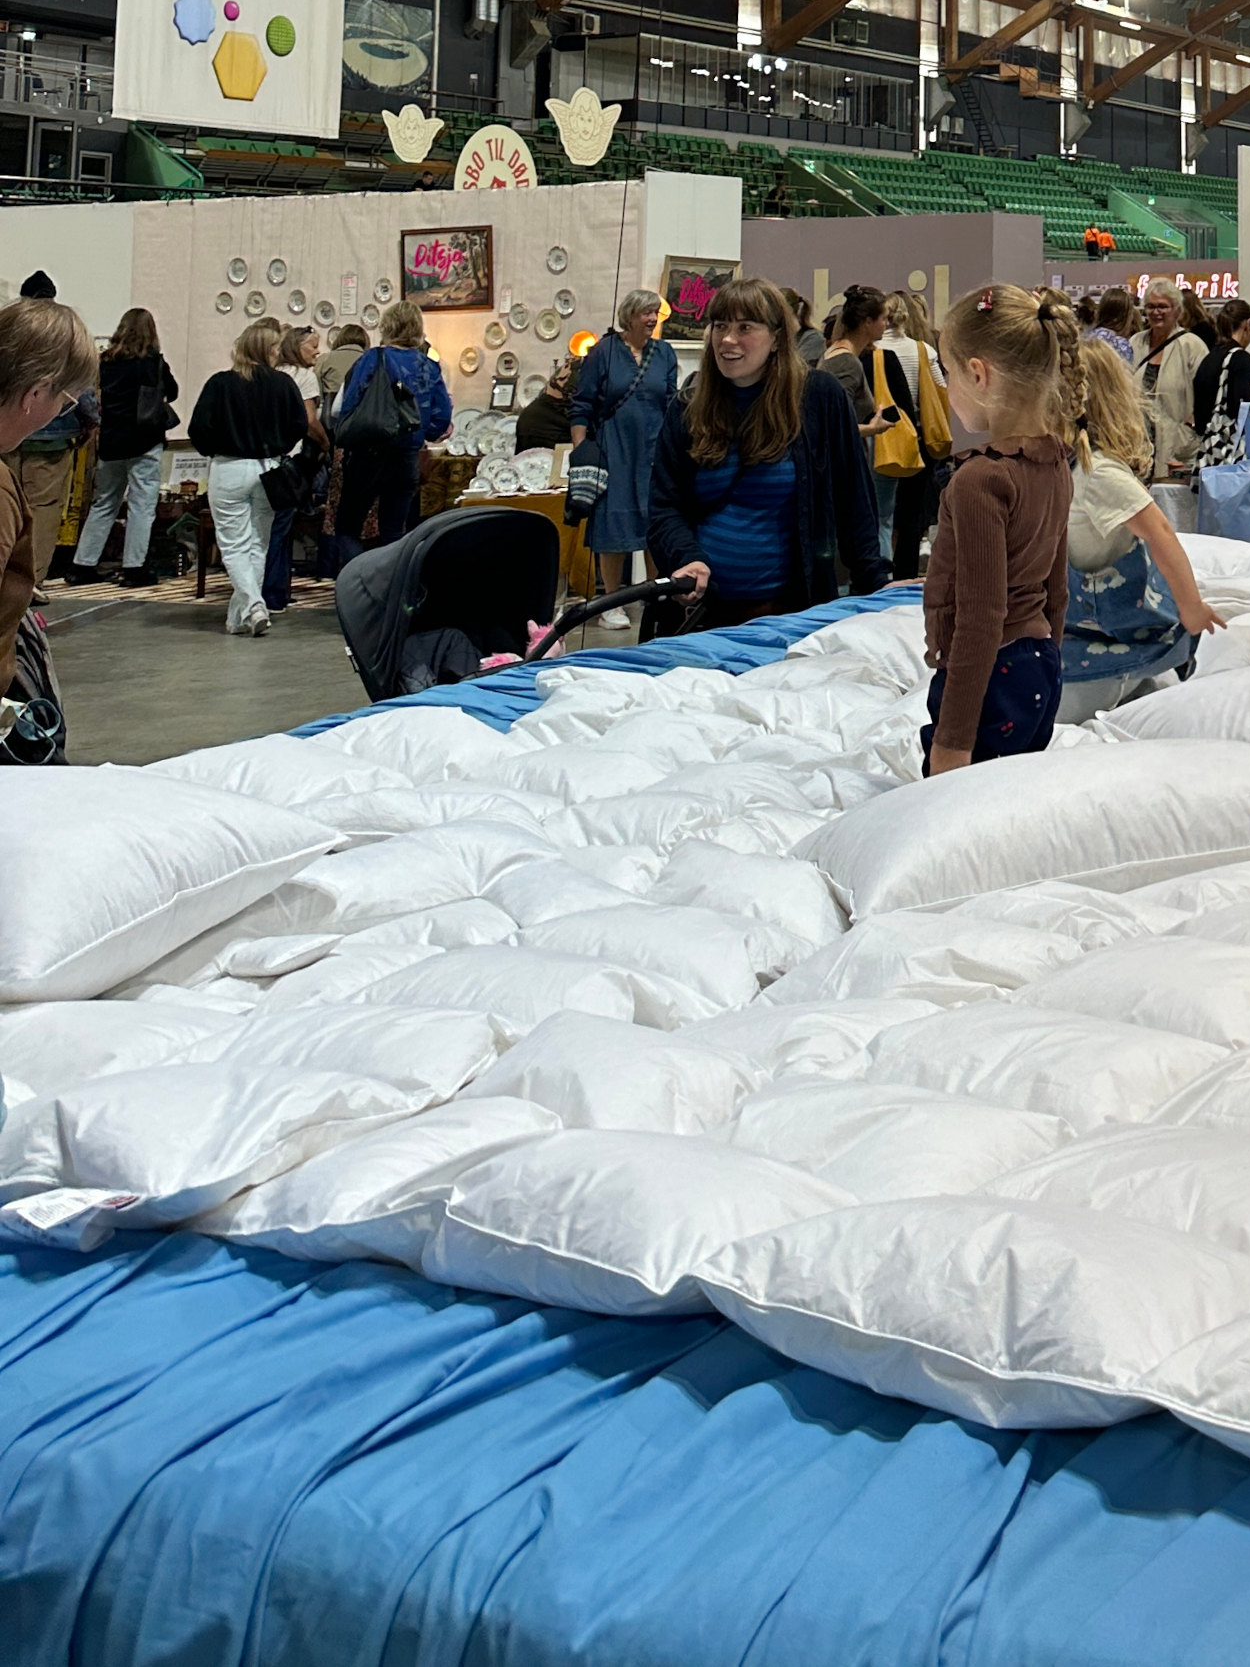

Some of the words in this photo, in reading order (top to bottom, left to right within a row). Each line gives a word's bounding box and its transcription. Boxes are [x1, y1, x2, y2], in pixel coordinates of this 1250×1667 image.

[485, 138, 505, 161] TIL
[407, 238, 464, 282] Ditsja
[1136, 273, 1240, 299] fbrik
